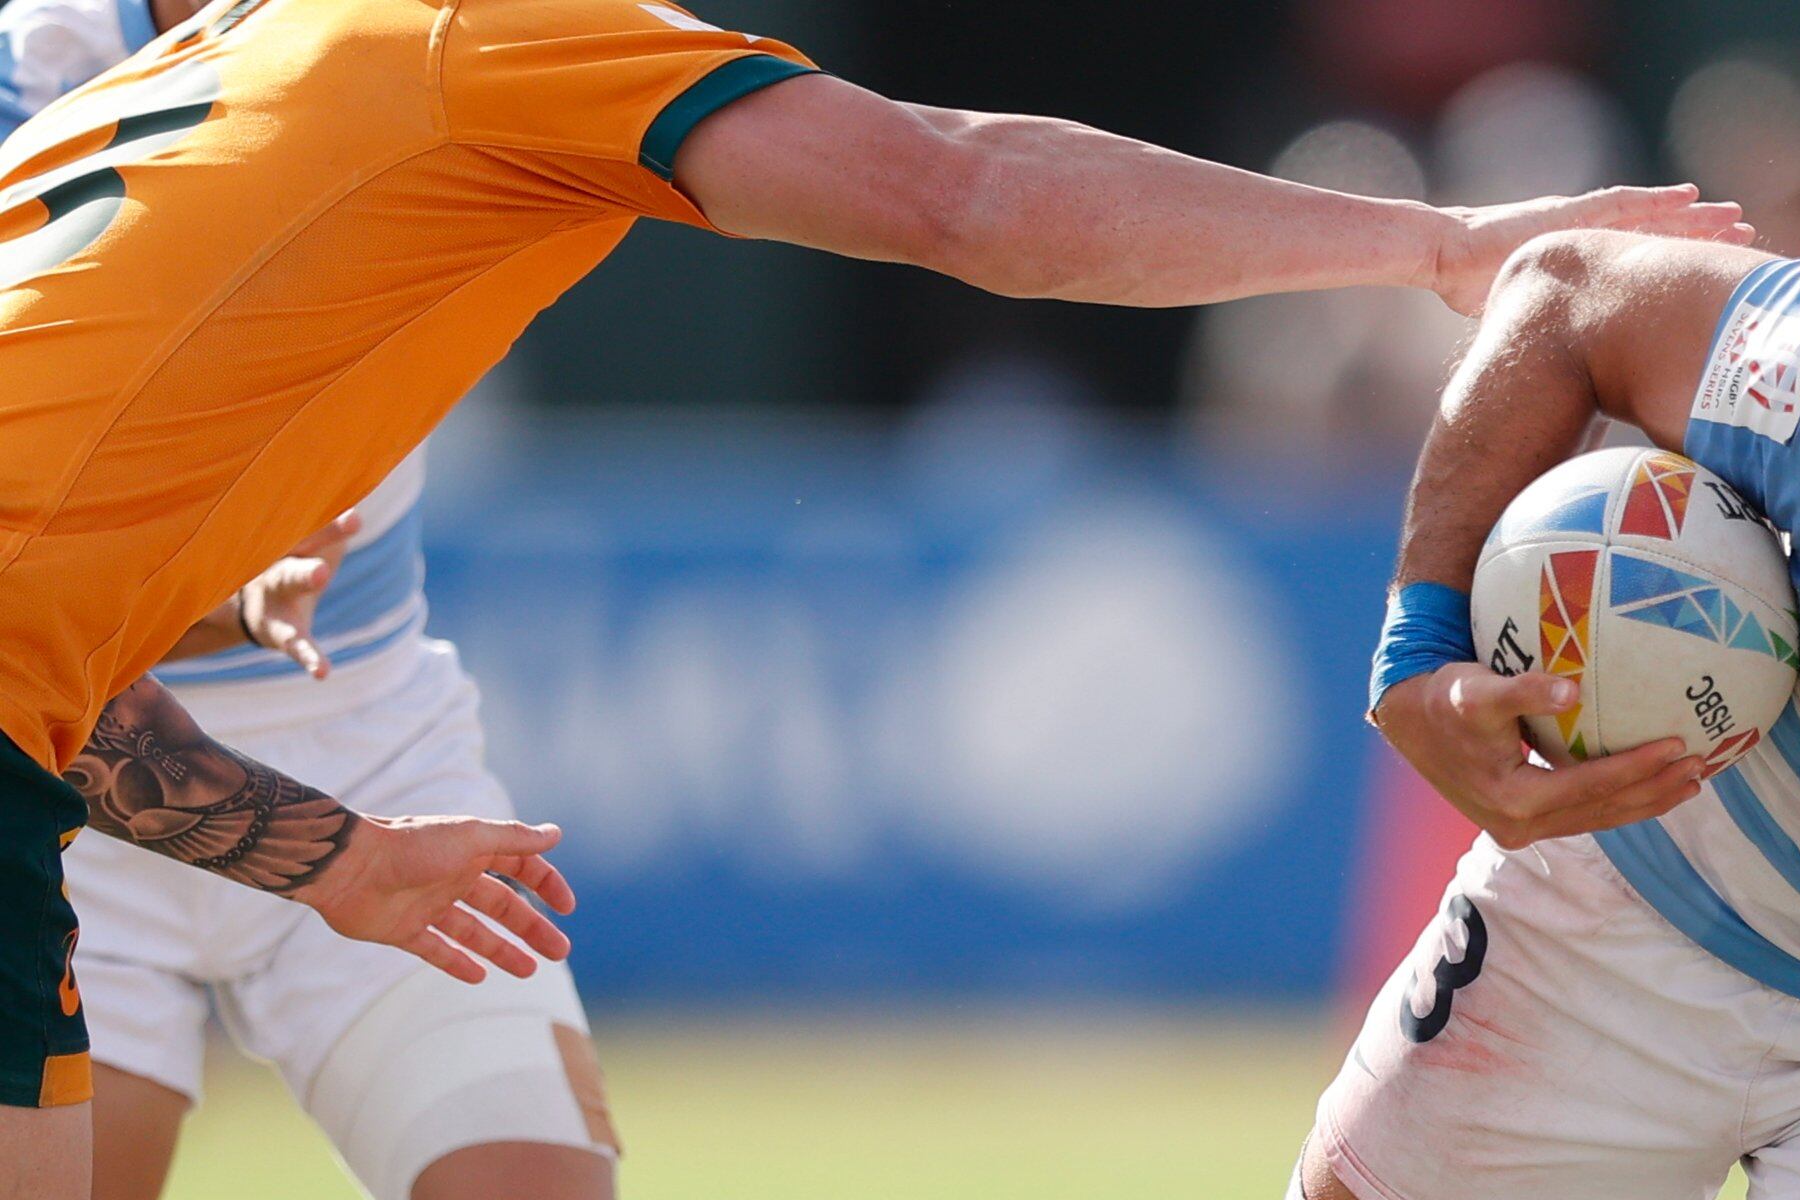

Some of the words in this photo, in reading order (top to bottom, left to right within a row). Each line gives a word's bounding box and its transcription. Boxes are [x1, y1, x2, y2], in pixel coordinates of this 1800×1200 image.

[1701, 364, 1721, 410] SERIES
[1728, 366, 1744, 409] RUGBY
[1686, 675, 1735, 741] HSBC
[1400, 894, 1488, 1043] 3
